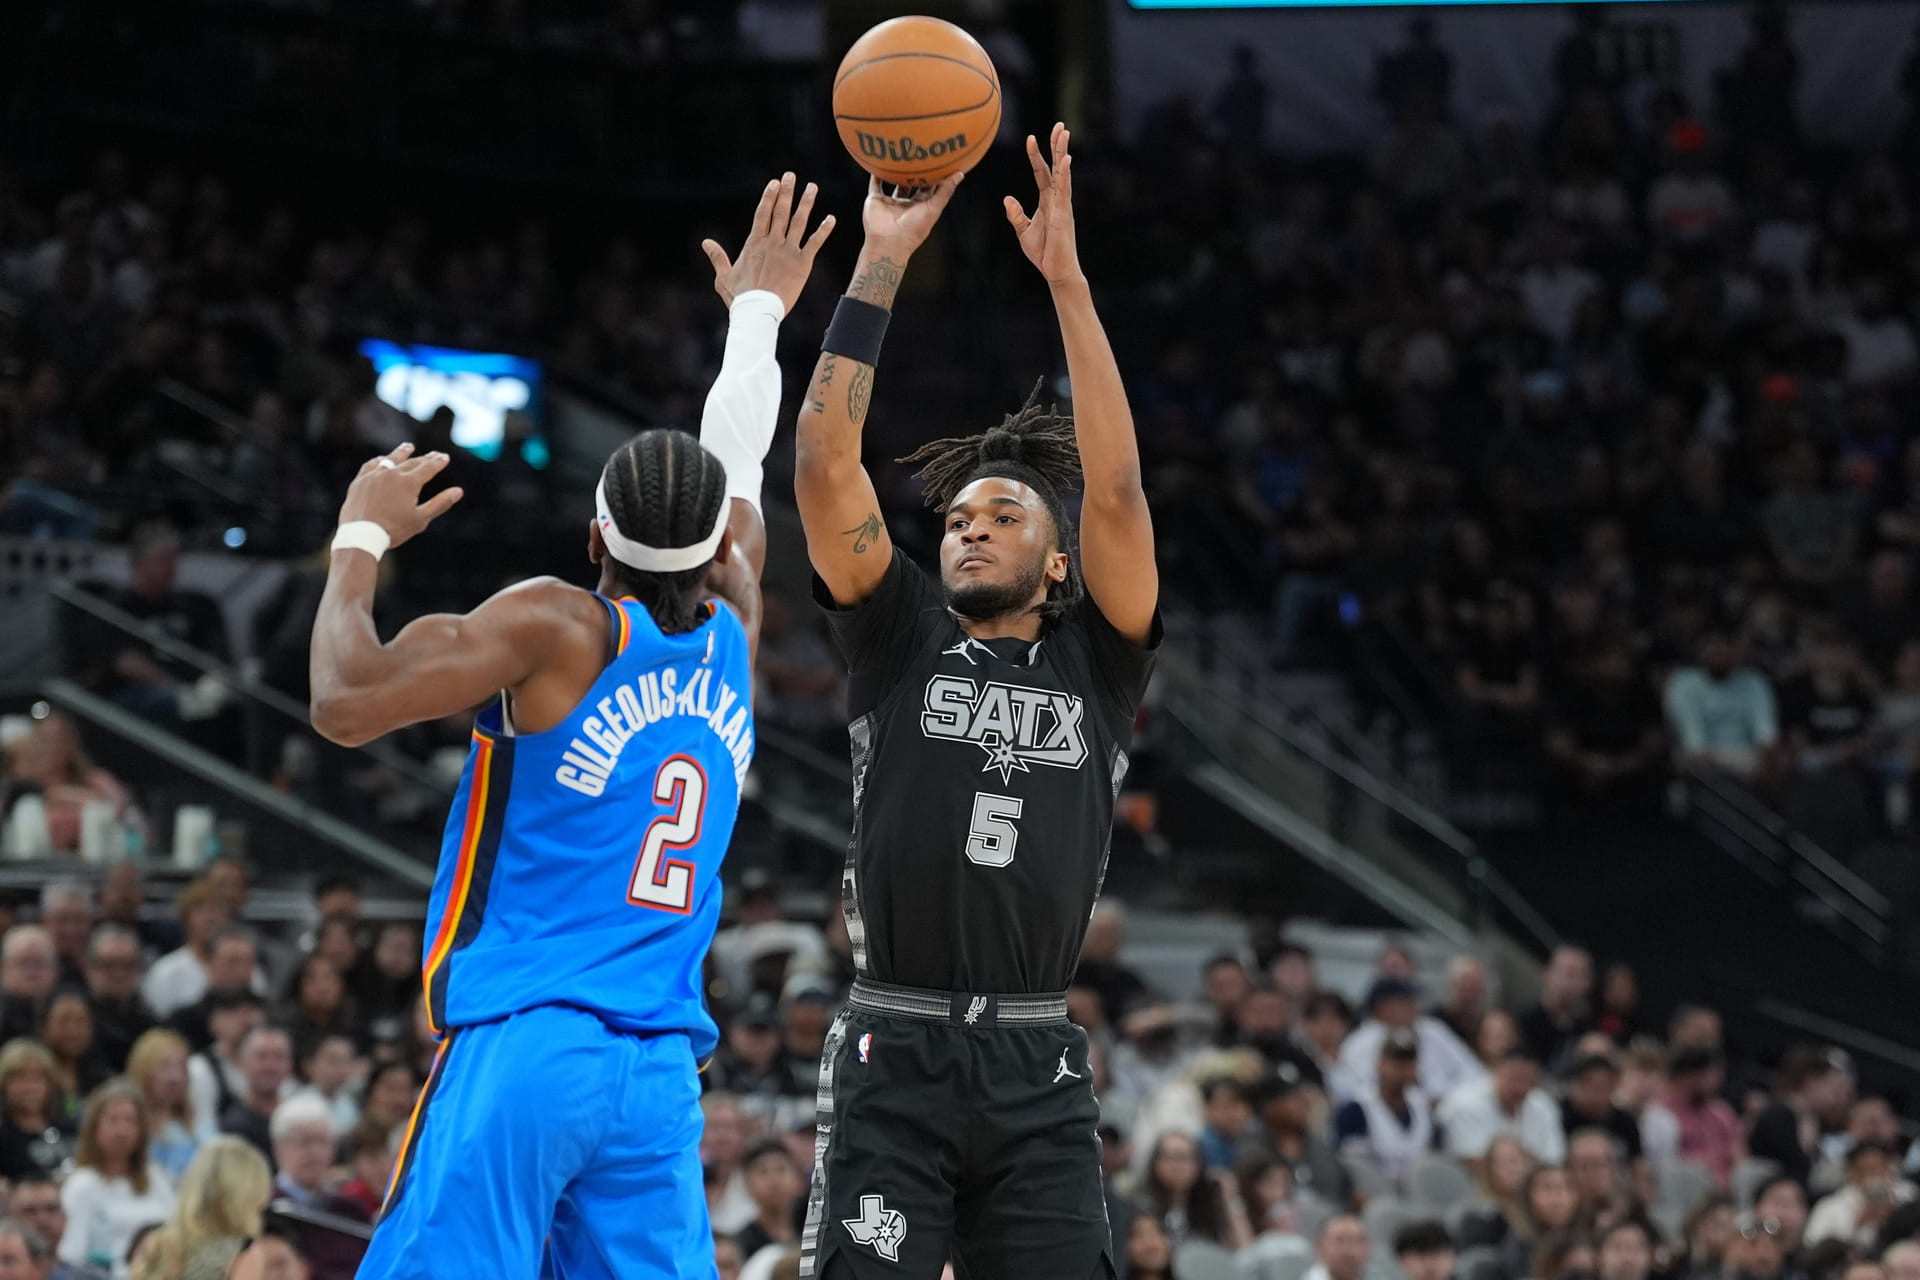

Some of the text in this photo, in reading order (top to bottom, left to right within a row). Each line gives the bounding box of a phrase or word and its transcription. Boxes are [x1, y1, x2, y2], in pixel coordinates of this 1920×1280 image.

[856, 130, 967, 161] Wilson
[920, 674, 1088, 772] SATX
[627, 753, 708, 915] 2
[965, 791, 1024, 868] 5
